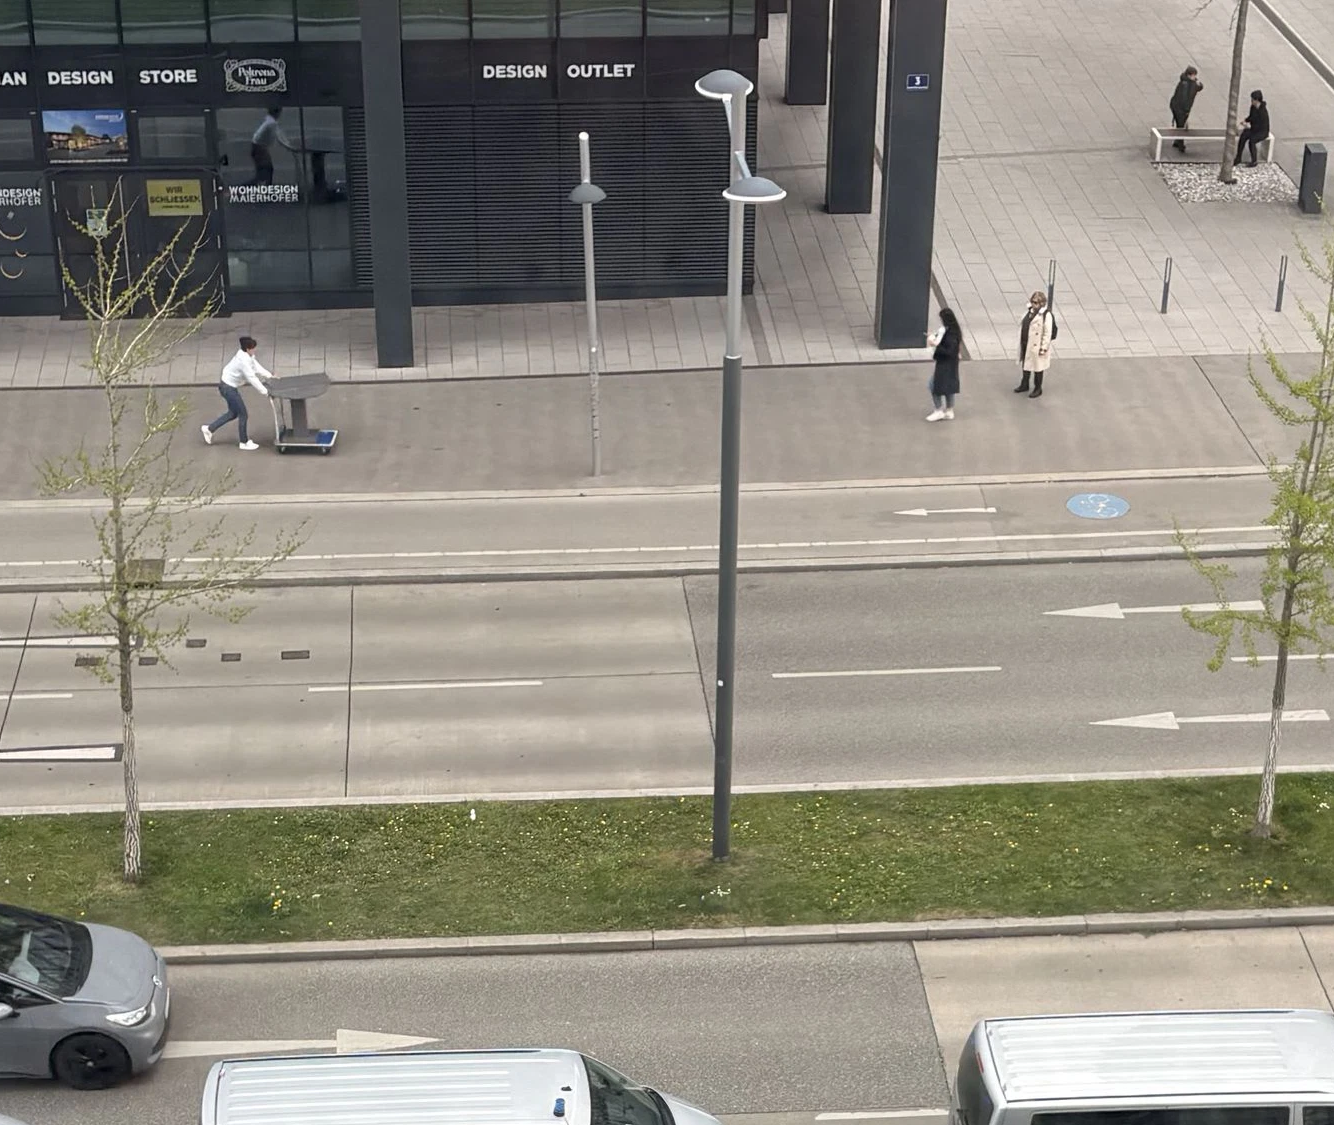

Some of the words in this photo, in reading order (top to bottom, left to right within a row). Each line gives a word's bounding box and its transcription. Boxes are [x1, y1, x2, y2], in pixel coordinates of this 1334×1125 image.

[238, 66, 276, 78] Poltrona
[482, 64, 548, 79] DESIGN
[567, 63, 635, 78] OUTLET
[47, 70, 114, 86] DESIGN
[139, 69, 198, 84] STORE
[245, 76, 267, 85] Frau
[914, 76, 921, 86] 3
[165, 186, 183, 194] WIR
[229, 185, 299, 194] WOHNDESIGN
[229, 193, 299, 203] MAIERHOFER
